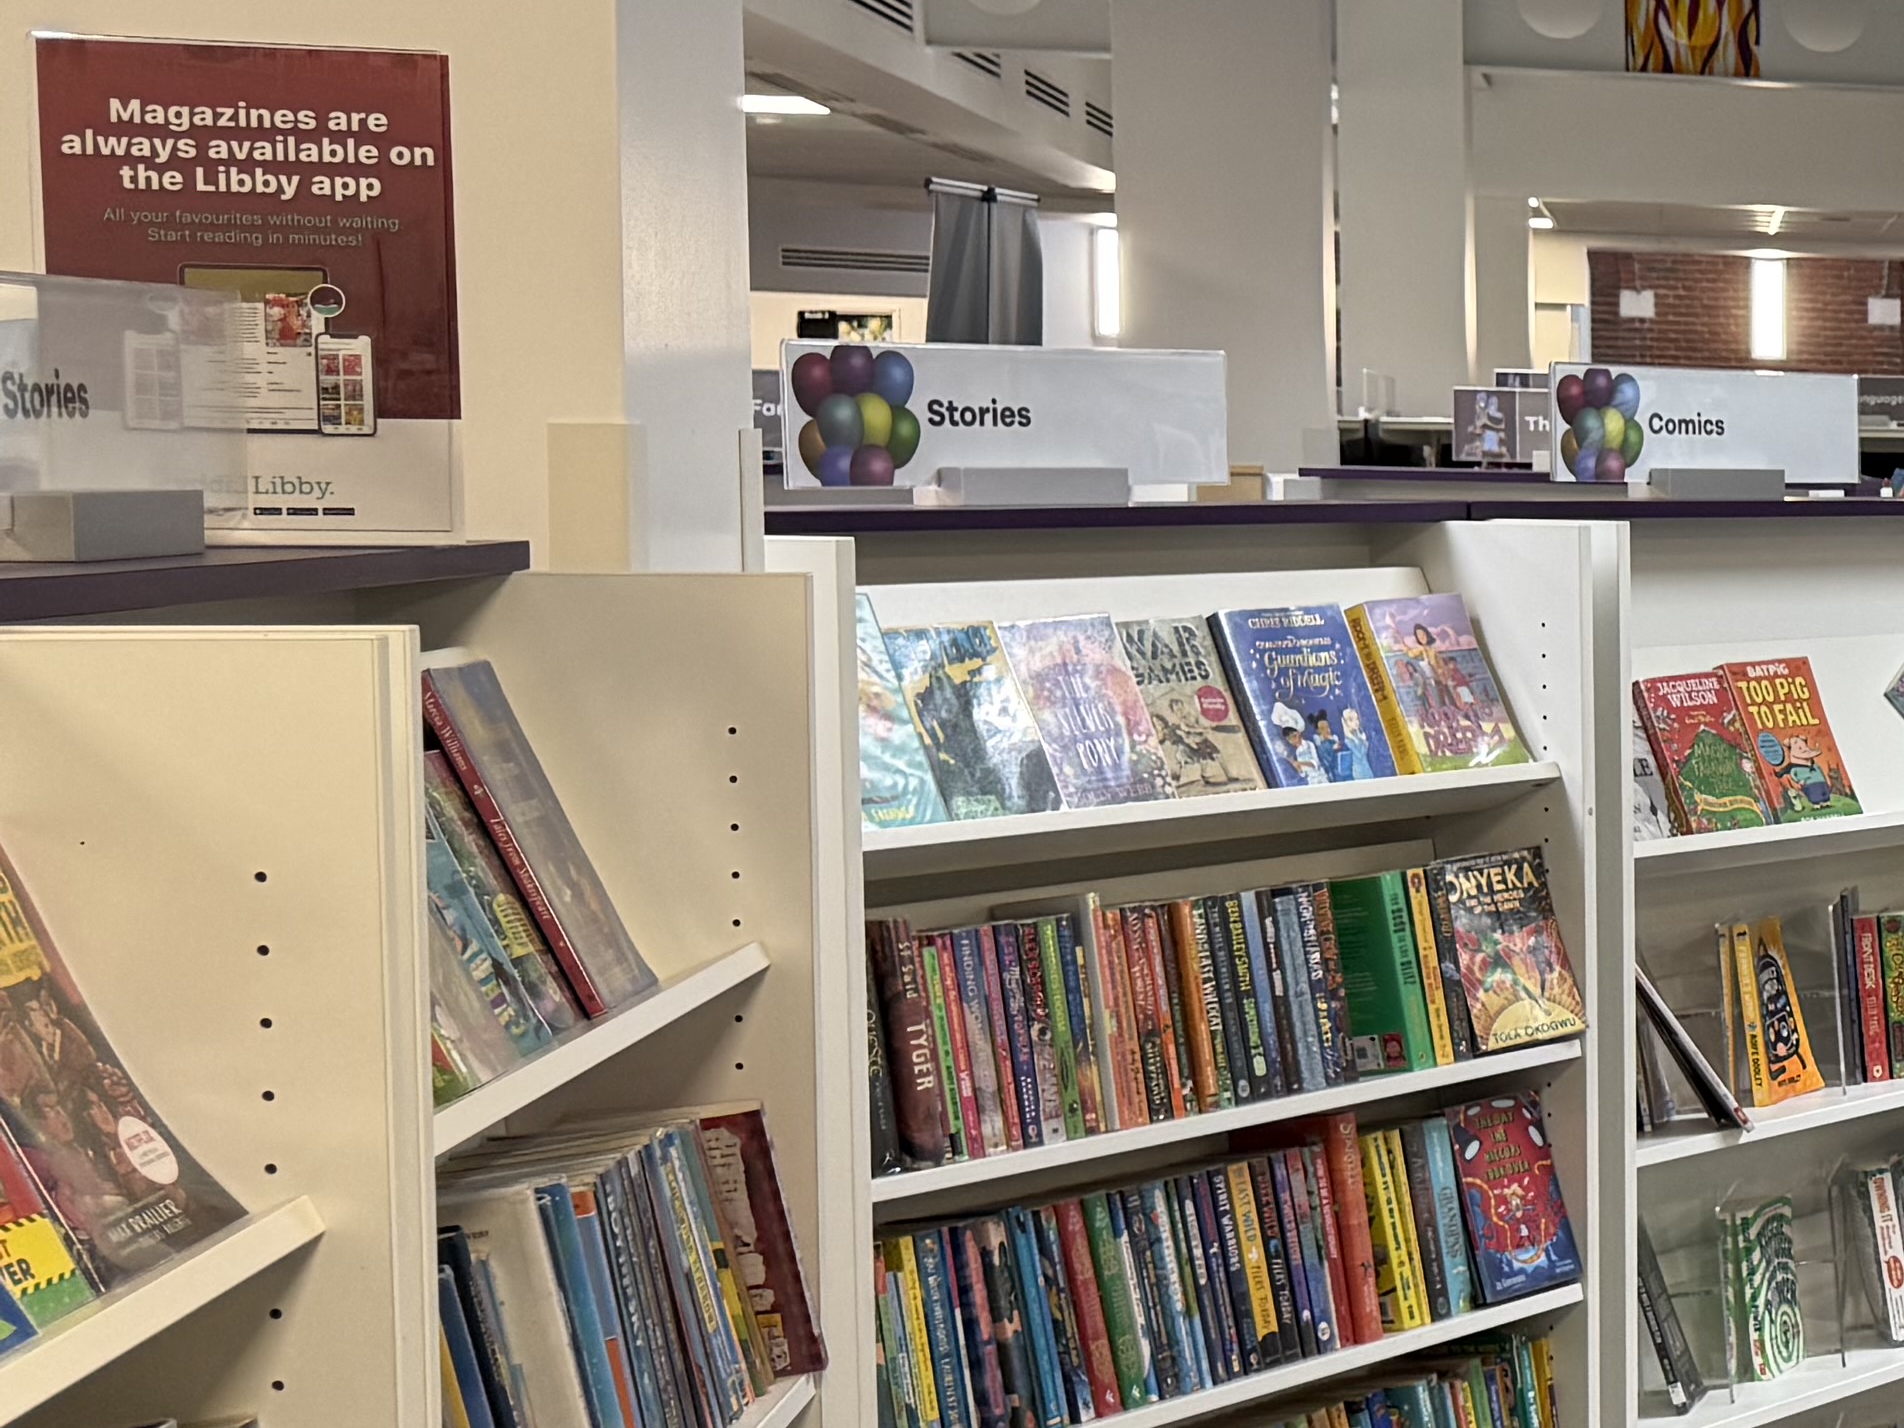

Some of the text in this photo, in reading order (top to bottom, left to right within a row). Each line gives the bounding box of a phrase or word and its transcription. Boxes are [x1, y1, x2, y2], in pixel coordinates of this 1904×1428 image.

[109, 98, 389, 133] Magazines are
[60, 129, 435, 167] always available on
[119, 164, 382, 202] the Libby app
[103, 207, 125, 222] All
[130, 210, 168, 226] your
[175, 209, 263, 227] favourites
[268, 213, 332, 228] without
[147, 227, 364, 247] Start reading in minutes!
[1, 368, 90, 420] Stories
[927, 398, 1032, 427] Stories
[1648, 412, 1725, 436] Comics
[252, 475, 335, 501] Libby.
[1248, 615, 1282, 629] CHRIS
[1123, 624, 1201, 662] WAR
[1131, 659, 1212, 686] GAMES
[1264, 649, 1338, 678] Guardians
[1297, 669, 1342, 698] Magic
[1657, 677, 1720, 696] JACQUELINE
[1667, 690, 1718, 708] WILSON
[1738, 680, 1775, 704] TOO
[420, 690, 469, 772] Marcia Williams
[1748, 706, 1774, 730] TO
[1076, 738, 1121, 770] PONY
[488, 813, 514, 842] Tales
[1447, 863, 1540, 903] ONYEKA
[1225, 899, 1251, 990] BEN BAILEY SMITH
[958, 938, 978, 996] FINDING
[1399, 959, 1416, 986] BLITZ
[1859, 932, 1877, 989] FRONT DESK
[1202, 980, 1223, 1031] WILDCAT
[901, 964, 936, 1090] Said TYGER
[1493, 1018, 1577, 1045] TOLA OKOGWU
[1751, 1057, 1763, 1088] DOOLEY
[1874, 1176, 1892, 1223] OWNING IT
[1213, 1174, 1241, 1274] SPIRIT WARRIORS
[1277, 1289, 1294, 1325] TORDAY
